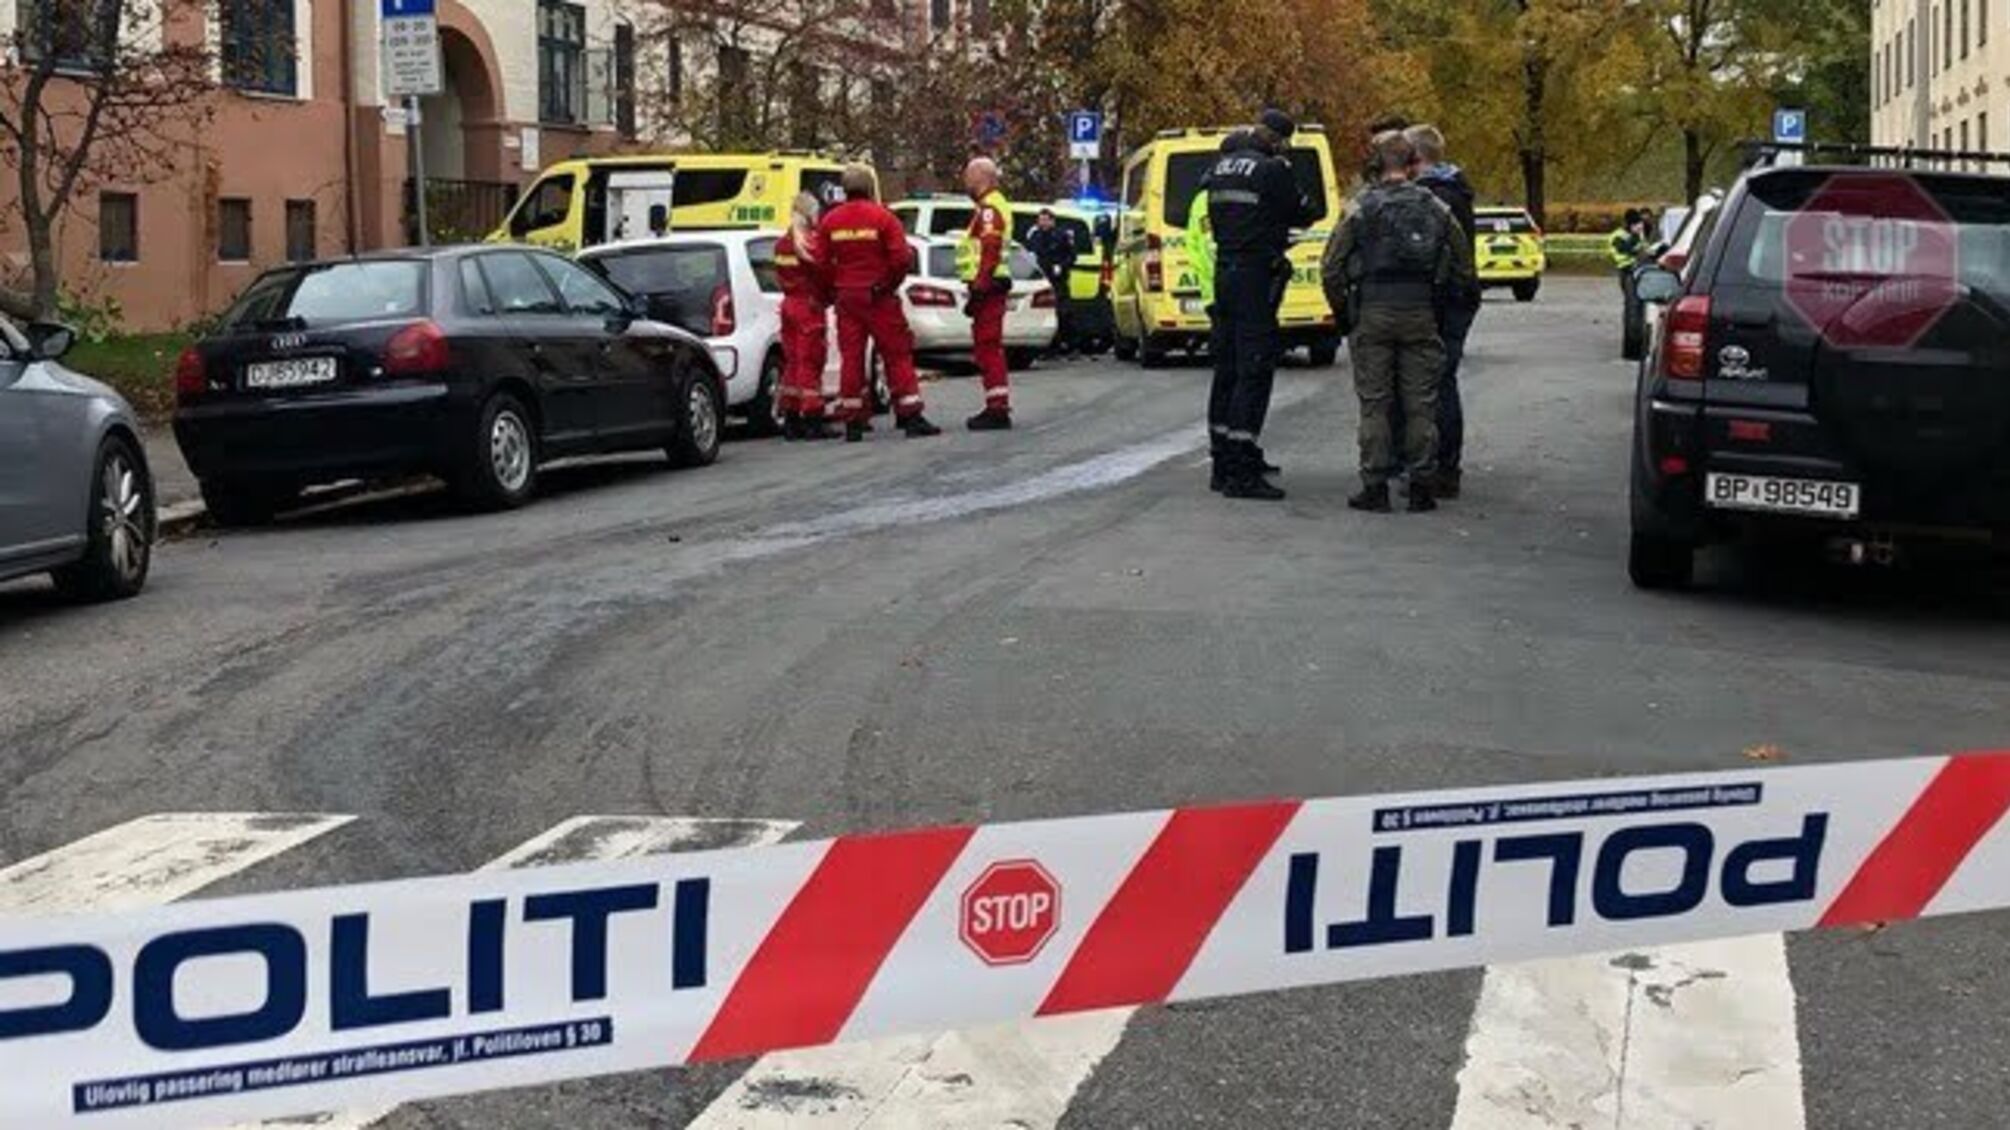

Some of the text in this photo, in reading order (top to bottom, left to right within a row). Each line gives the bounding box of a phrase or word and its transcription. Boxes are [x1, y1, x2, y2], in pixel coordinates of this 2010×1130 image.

[1076, 117, 1093, 139] P
[1782, 115, 1797, 135] P
[1714, 475, 1851, 509] BP 98549
[1285, 812, 1829, 953] POLITI
[973, 893, 1050, 933] STOP
[86, 1022, 601, 1106] Ulovlig passering medfører straffeansvar, jf. Politiloven § 30
